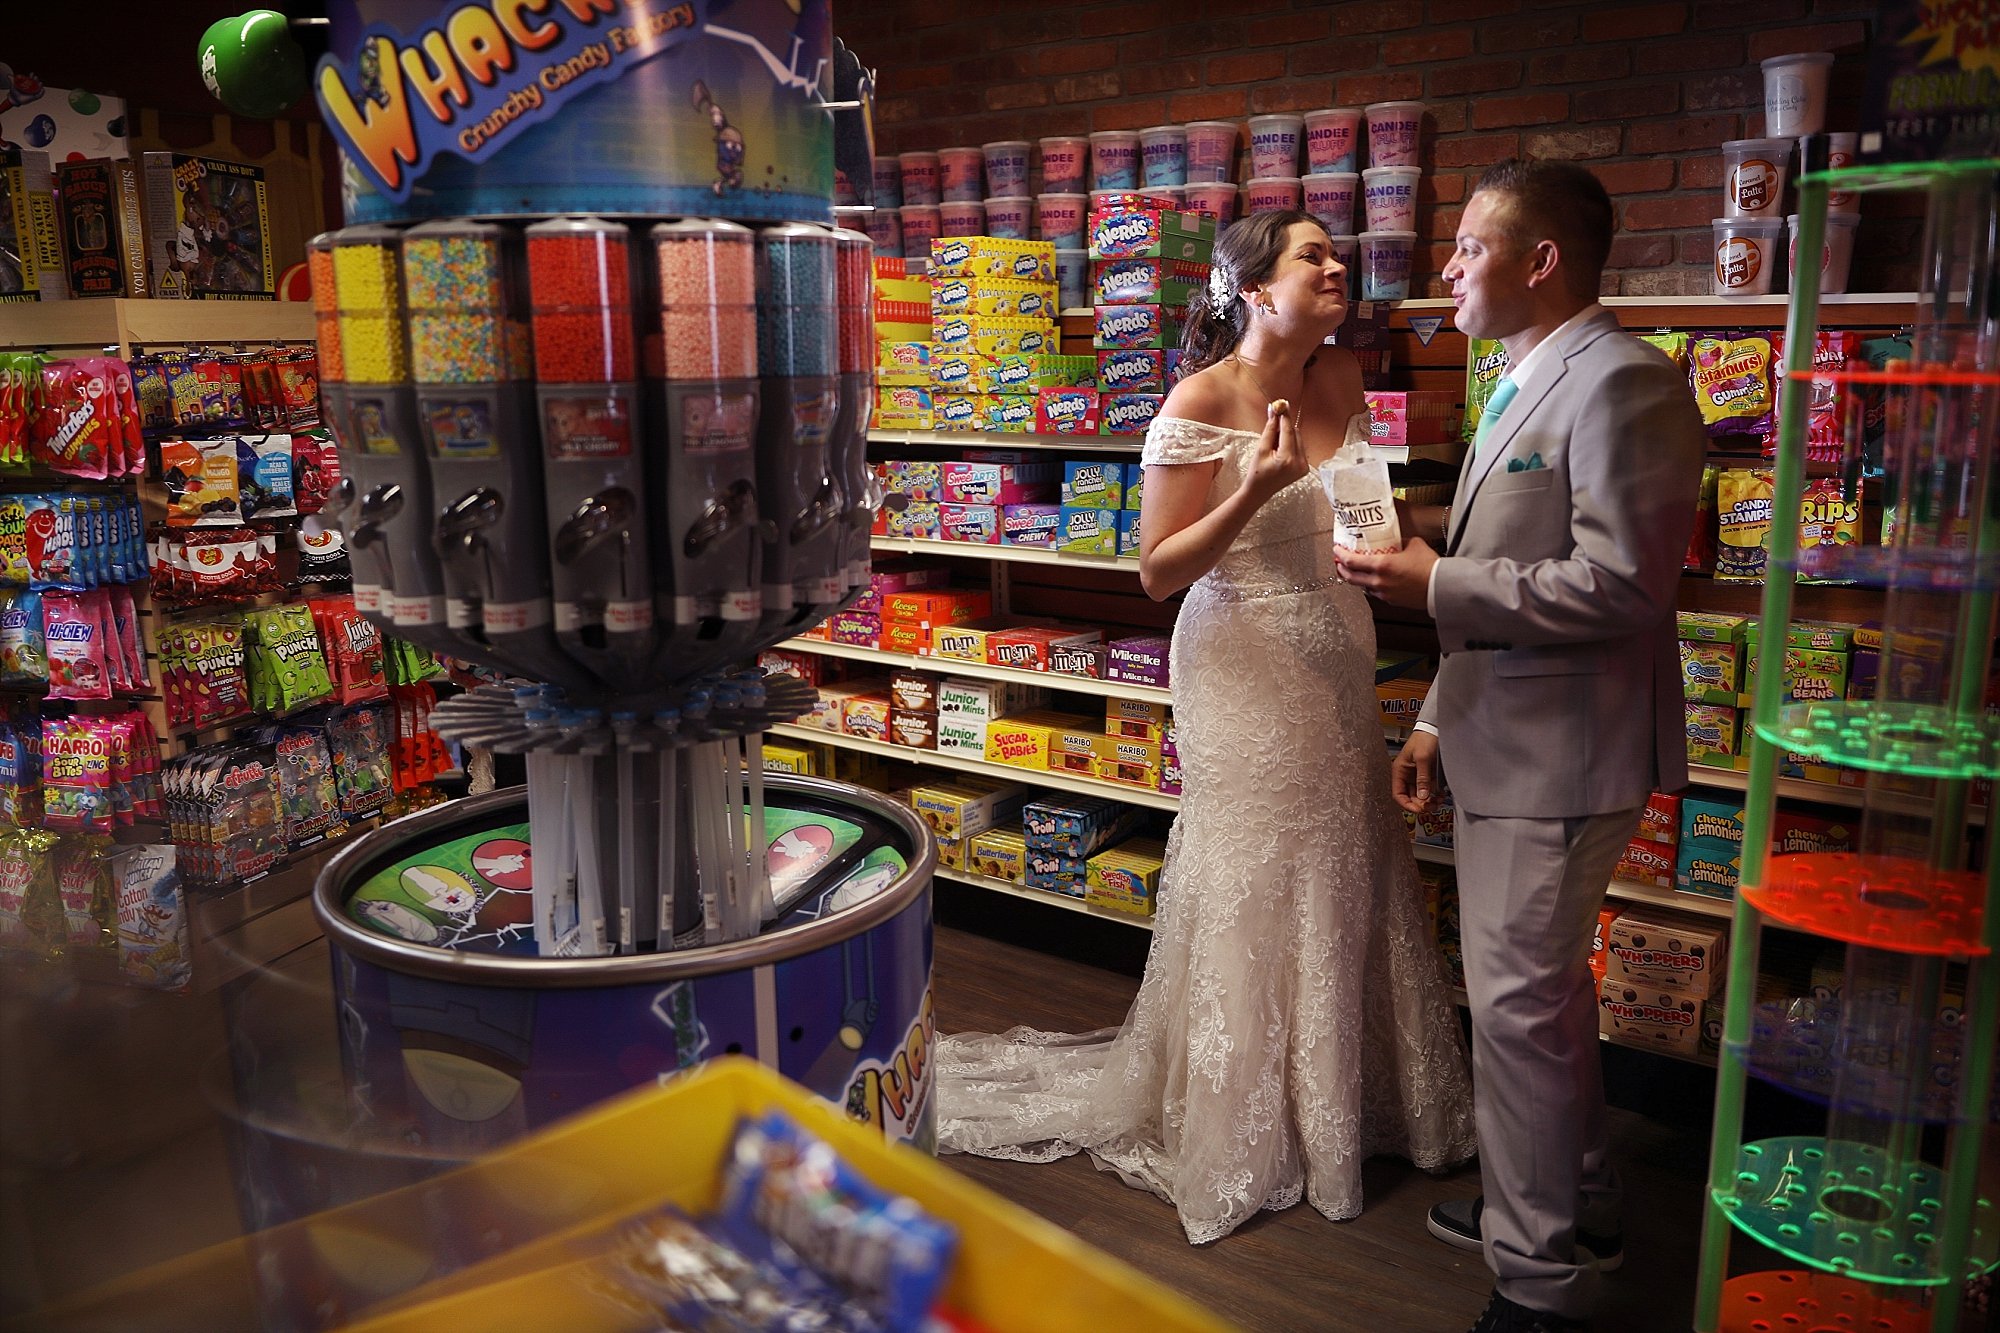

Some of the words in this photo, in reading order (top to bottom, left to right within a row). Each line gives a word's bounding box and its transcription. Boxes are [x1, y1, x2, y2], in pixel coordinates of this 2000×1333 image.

[458, 80, 543, 153] Crunchy
[540, 41, 612, 92] Candy
[607, 2, 696, 53] Factory
[1371, 121, 1418, 134] CANDEE
[1252, 133, 1295, 145] CANDEE
[1308, 128, 1349, 141] CANDEE
[122, 169, 136, 194] THIS
[1307, 191, 1353, 203] CANDEE
[1365, 185, 1411, 198] CANDEE
[1740, 187, 1764, 200] Latte
[1368, 196, 1407, 209] FLUFF
[125, 195, 139, 241] HANDLE
[134, 271, 146, 294] YOU
[893, 346, 919, 356] Swedish
[899, 354, 914, 364] Fish
[1697, 352, 1764, 386] Starburst
[893, 391, 919, 402] Swedish
[899, 400, 914, 408] Fish
[64, 418, 101, 461] GUMMIES
[1075, 465, 1101, 480] JOLLY
[206, 482, 233, 491] MANGUE
[1077, 477, 1103, 487] rancher
[961, 485, 986, 493] Original
[1075, 484, 1106, 494] GUMMIES
[1734, 499, 1771, 512] CANDY
[1800, 499, 1859, 524] Rips
[1069, 512, 1096, 526] JOLLY
[1719, 508, 1772, 525] STAMPE
[957, 525, 981, 533] Original
[1070, 522, 1097, 532] rancher
[1018, 532, 1048, 542] CHEWY
[1069, 529, 1099, 539] GUMMIES
[47, 622, 94, 642] HI-CHEW
[838, 620, 873, 635] Spree
[280, 631, 304, 645] SOUR
[204, 645, 233, 660] SOUR
[276, 637, 318, 662] PUNCH
[293, 652, 311, 662] BITES
[1111, 649, 1140, 663] Mike
[1143, 655, 1161, 667] Ike
[197, 653, 244, 676] PUNCH
[214, 667, 235, 678] BITES
[1122, 672, 1142, 681] Mike
[1143, 675, 1156, 684] Ike
[892, 678, 927, 692] Junior
[1795, 677, 1831, 689] JELLY
[902, 689, 932, 699] Caramels
[941, 690, 979, 706] Junior
[1792, 688, 1834, 699] BEANS
[961, 704, 985, 715] Mints
[1120, 702, 1150, 713] HARIBO
[1380, 698, 1406, 713] Milk
[892, 716, 927, 729] Junior
[1122, 712, 1148, 720] Goldbears
[846, 715, 867, 726] Cookie
[866, 716, 886, 732] Dough
[902, 726, 933, 736] Caramels
[940, 726, 977, 741] Junior
[959, 739, 983, 751] Mints
[994, 733, 1029, 748] SUGAR
[1063, 735, 1091, 747] HARIBO
[1002, 743, 1038, 760] BABIES
[1065, 746, 1089, 754] Goldbears
[1117, 745, 1147, 757] HARIBO
[1119, 755, 1145, 764] Goldbears
[917, 797, 956, 814] Butterfinger
[1029, 819, 1056, 836] Trolli
[1696, 813, 1735, 829] chewy
[1787, 829, 1827, 844] chewy
[976, 846, 1018, 862] Butterfinger
[1629, 848, 1670, 870] HOTS
[1033, 858, 1060, 875] Trolli
[1692, 860, 1729, 875] chewy
[1100, 870, 1132, 885] Swedish
[1107, 878, 1126, 890] Fish
[1615, 948, 1703, 970] WHOPPERS
[1606, 1001, 1694, 1026] WHOPPERS
